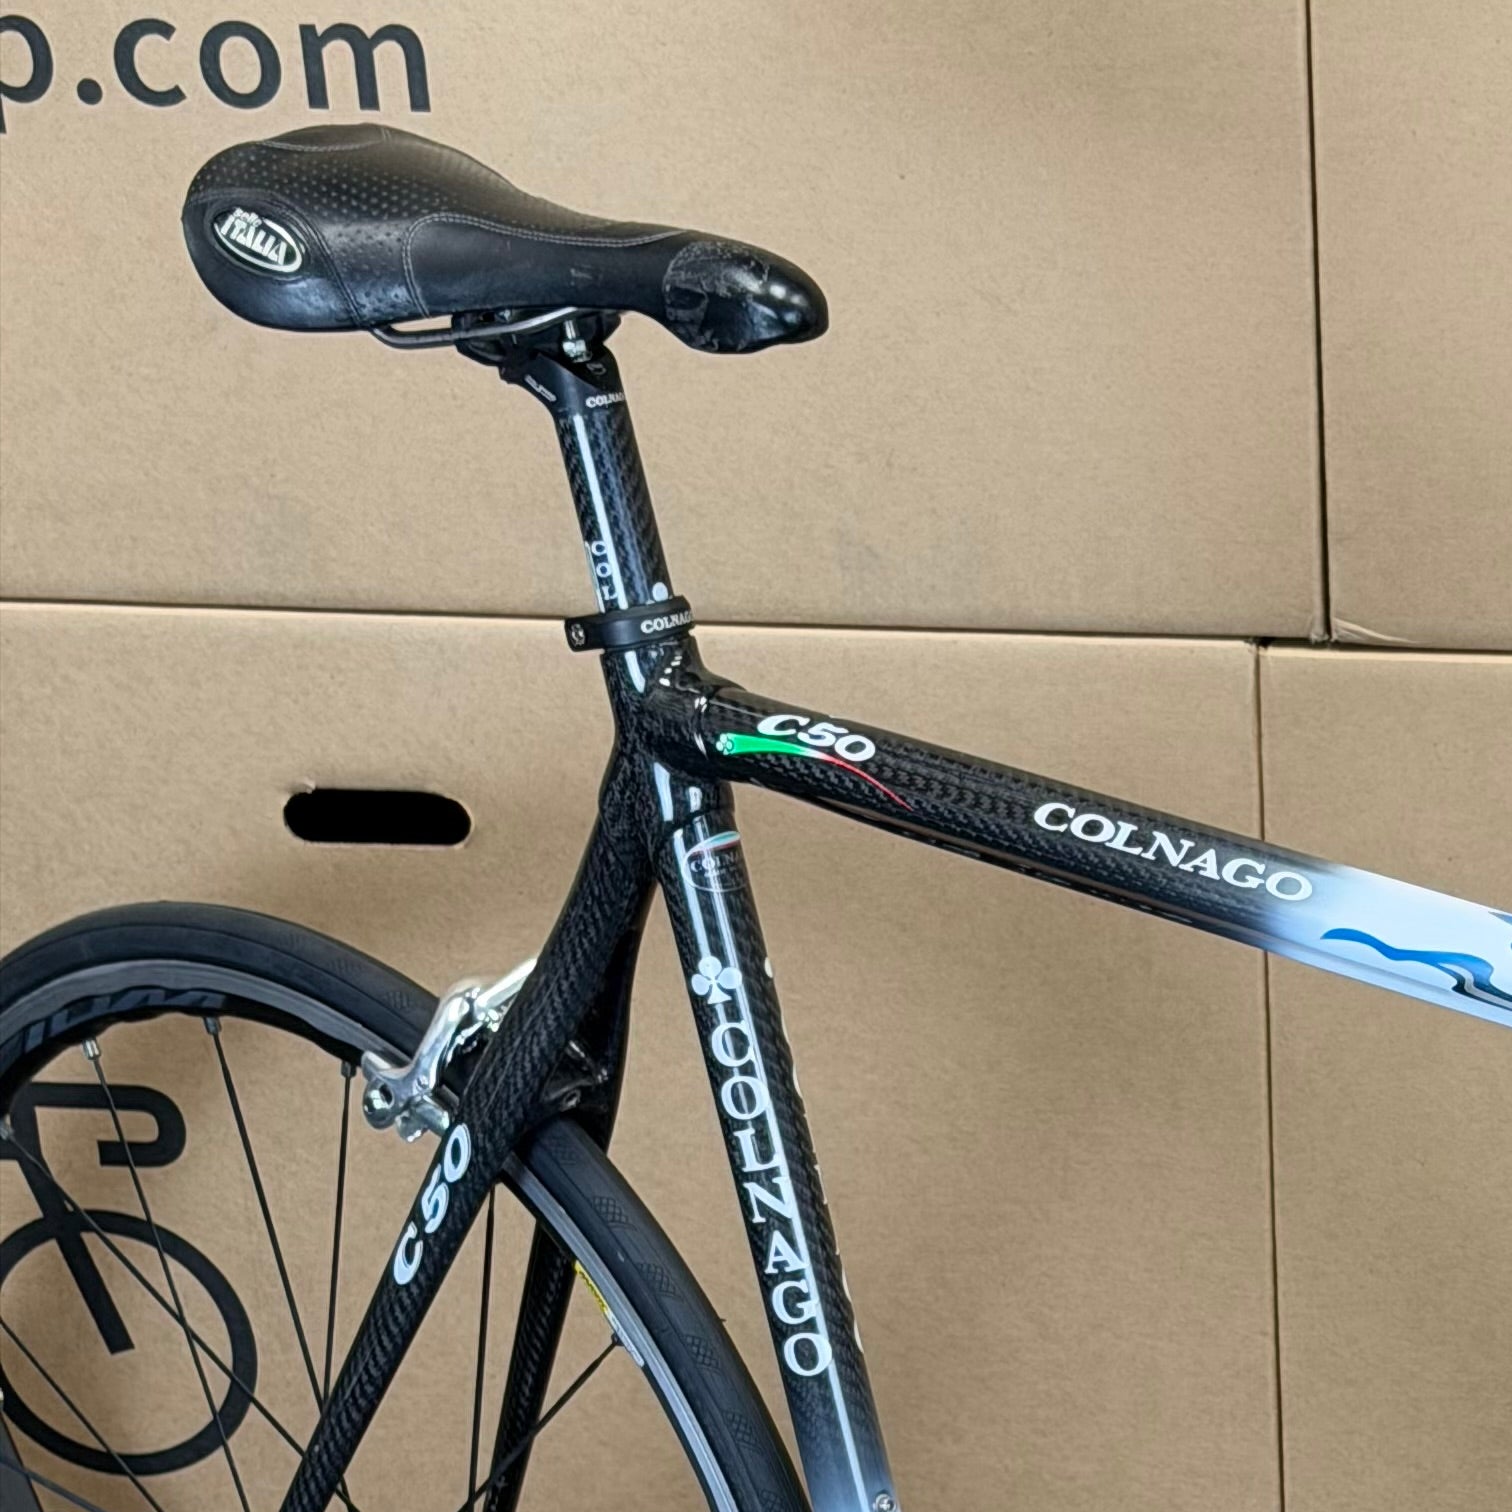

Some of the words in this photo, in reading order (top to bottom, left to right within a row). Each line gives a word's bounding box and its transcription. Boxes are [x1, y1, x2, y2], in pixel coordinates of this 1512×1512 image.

[757, 713, 876, 763] C50
[1033, 801, 1313, 901] COLNAGO
[393, 1125, 470, 1286] C50
[711, 1021, 833, 1377] COLNAGO
